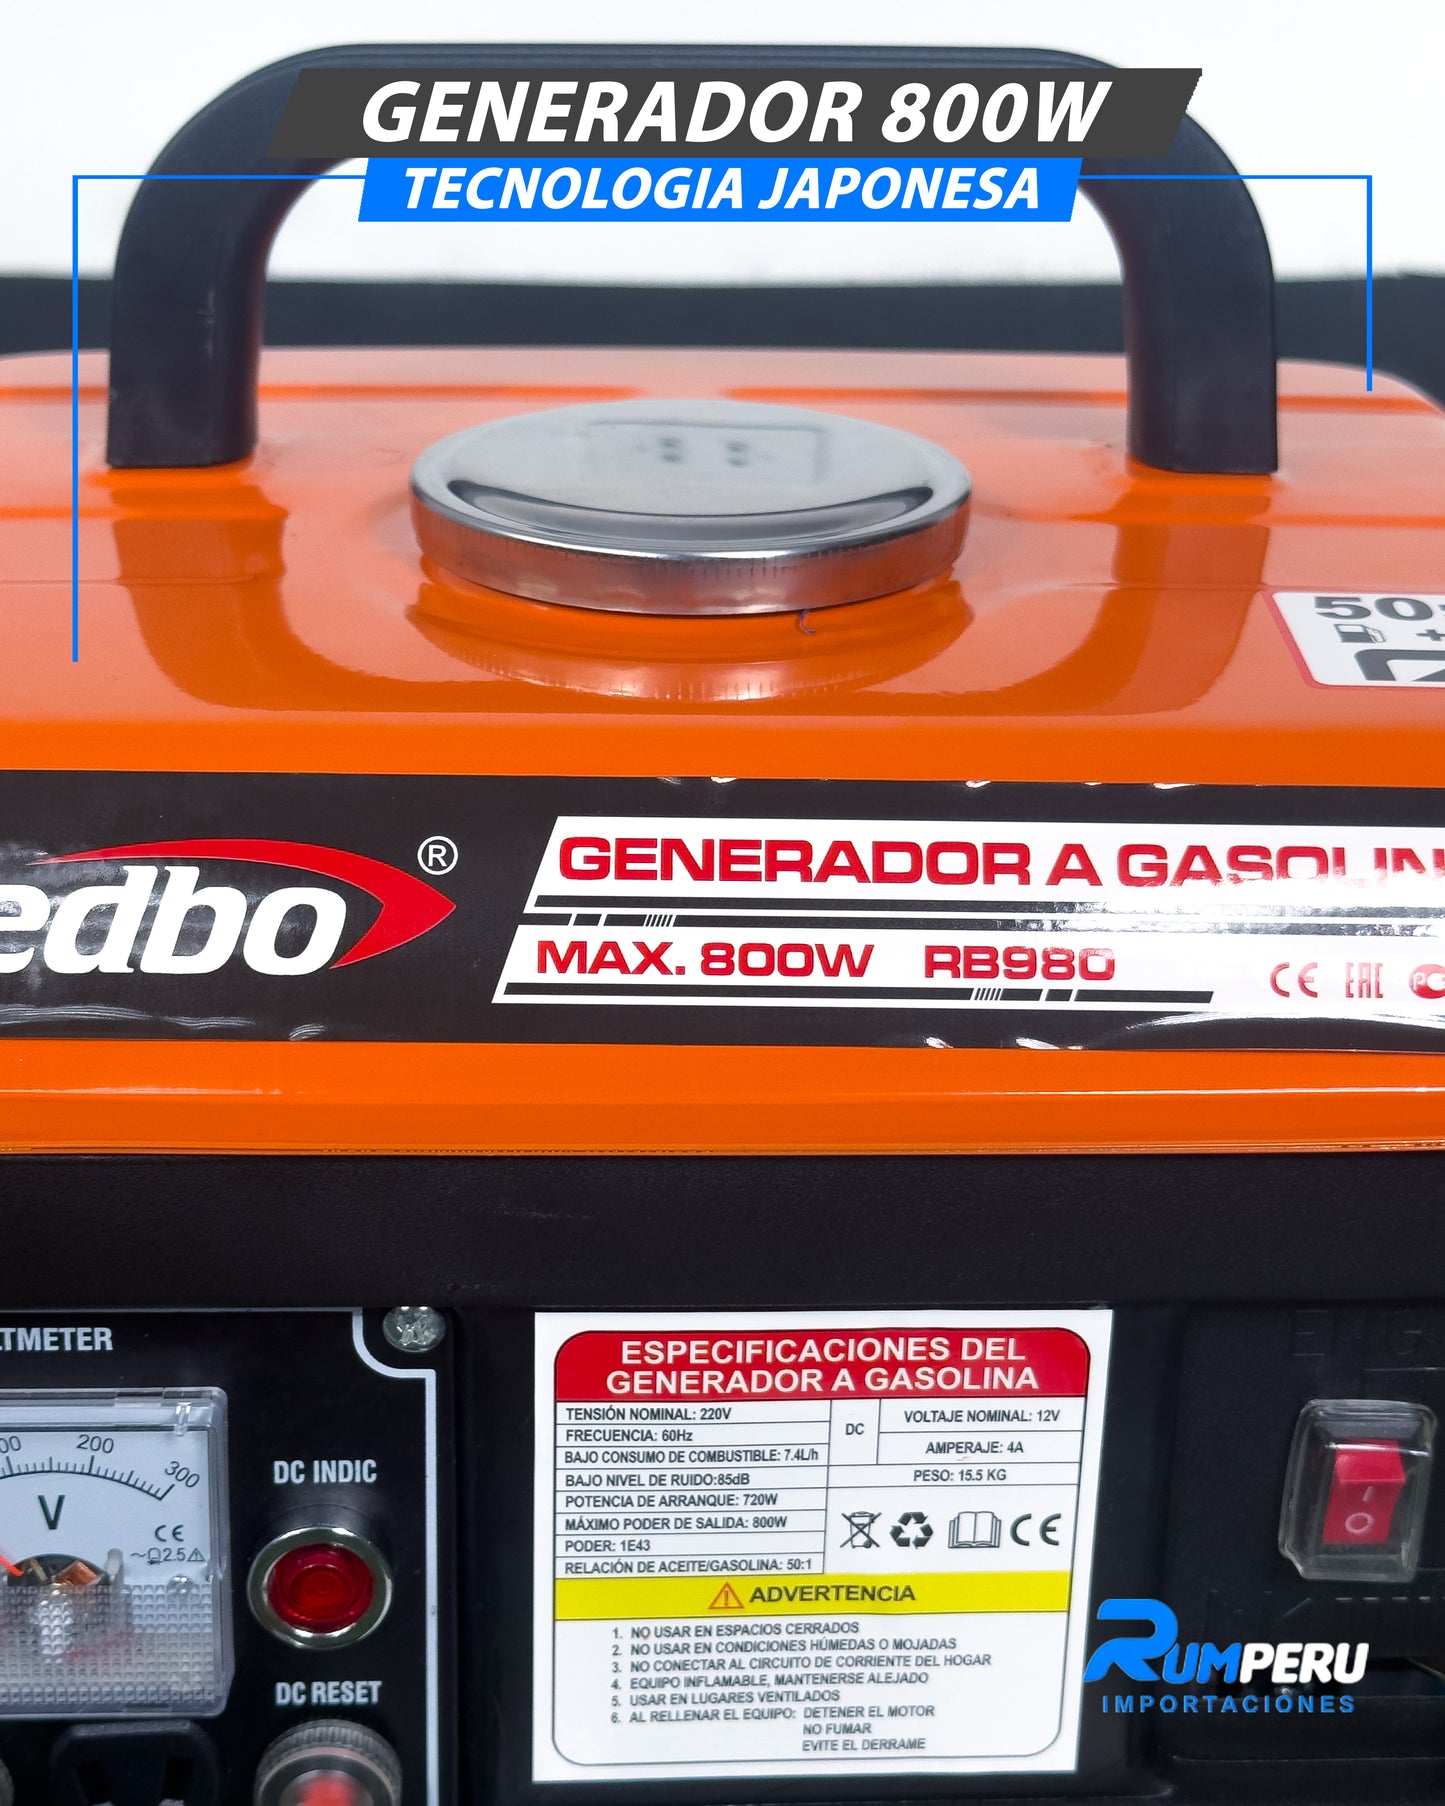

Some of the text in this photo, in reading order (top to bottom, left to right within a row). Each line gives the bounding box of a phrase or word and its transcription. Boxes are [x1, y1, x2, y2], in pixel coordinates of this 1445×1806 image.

[1314, 596, 1445, 622] 50
[559, 836, 1031, 886] GENERADOR
[1045, 842, 1102, 886] A
[537, 941, 1115, 980] MAX. 800W RB980
[0, 1327, 113, 1351] TMETER
[621, 1338, 1025, 1364] ESPECIFICACIONES DEL
[606, 1367, 1038, 1395] GENERADOR A GASOLINA
[566, 1405, 732, 1421] TENSIÓN NOMINAL: 220V
[904, 1410, 1060, 1423] VOLTAJE NOMINAL: 12V
[566, 1428, 693, 1443] FRECUENCIA: 60Hz
[845, 1423, 864, 1435] DC
[564, 1448, 819, 1464] BAJO CONSUMO DE COMBUSTIBLE: 7.4L/h
[925, 1441, 1024, 1454] AMPERAJE: 4A
[76, 1434, 115, 1454] 200
[164, 1460, 200, 1488] 300
[273, 1459, 378, 1483] DC INDIC
[913, 1469, 1007, 1481] PESO: 15.5 KG
[565, 1474, 603, 1487] BAJO
[606, 1474, 645, 1486] NIVEL
[650, 1474, 666, 1486] DE
[565, 1493, 778, 1508] POTENCIA DE ARRANQUE: 720W
[37, 1494, 66, 1530] V
[565, 1516, 787, 1531] MÁXIMO PODER DE SALIDA: 800W
[565, 1540, 651, 1553] PODER: 1E43
[565, 1559, 812, 1574] RELACIÓN DE ACEITE/GASOLINA: 50:1
[749, 1585, 916, 1603] ADVERTENCIA
[612, 1622, 859, 1639] 1. NO USAR EN ESPACIOS CERRADOS
[612, 1637, 956, 1656] 2. NO USAR EN CONDICIONES HÚMEDAS O MOJADAS
[612, 1653, 992, 1673] 3. NO CONECTAR AL CIRCUITO DE CORRIENTE DEL HOGAR
[611, 1671, 928, 1690] 4. EQUIPO INFLAMABLE, MANTENERSE ALEJADO
[275, 1681, 382, 1705] DC RESET
[611, 1689, 840, 1706] 5. USAR EN LUGARES VENTILADOS
[611, 1705, 934, 1723] 6. AL RELLENAR EL EQUIPO: DETENER EL MOTOR
[803, 1722, 871, 1735] NO FUMAR
[802, 1738, 926, 1751] EVITE EL DERRAME
